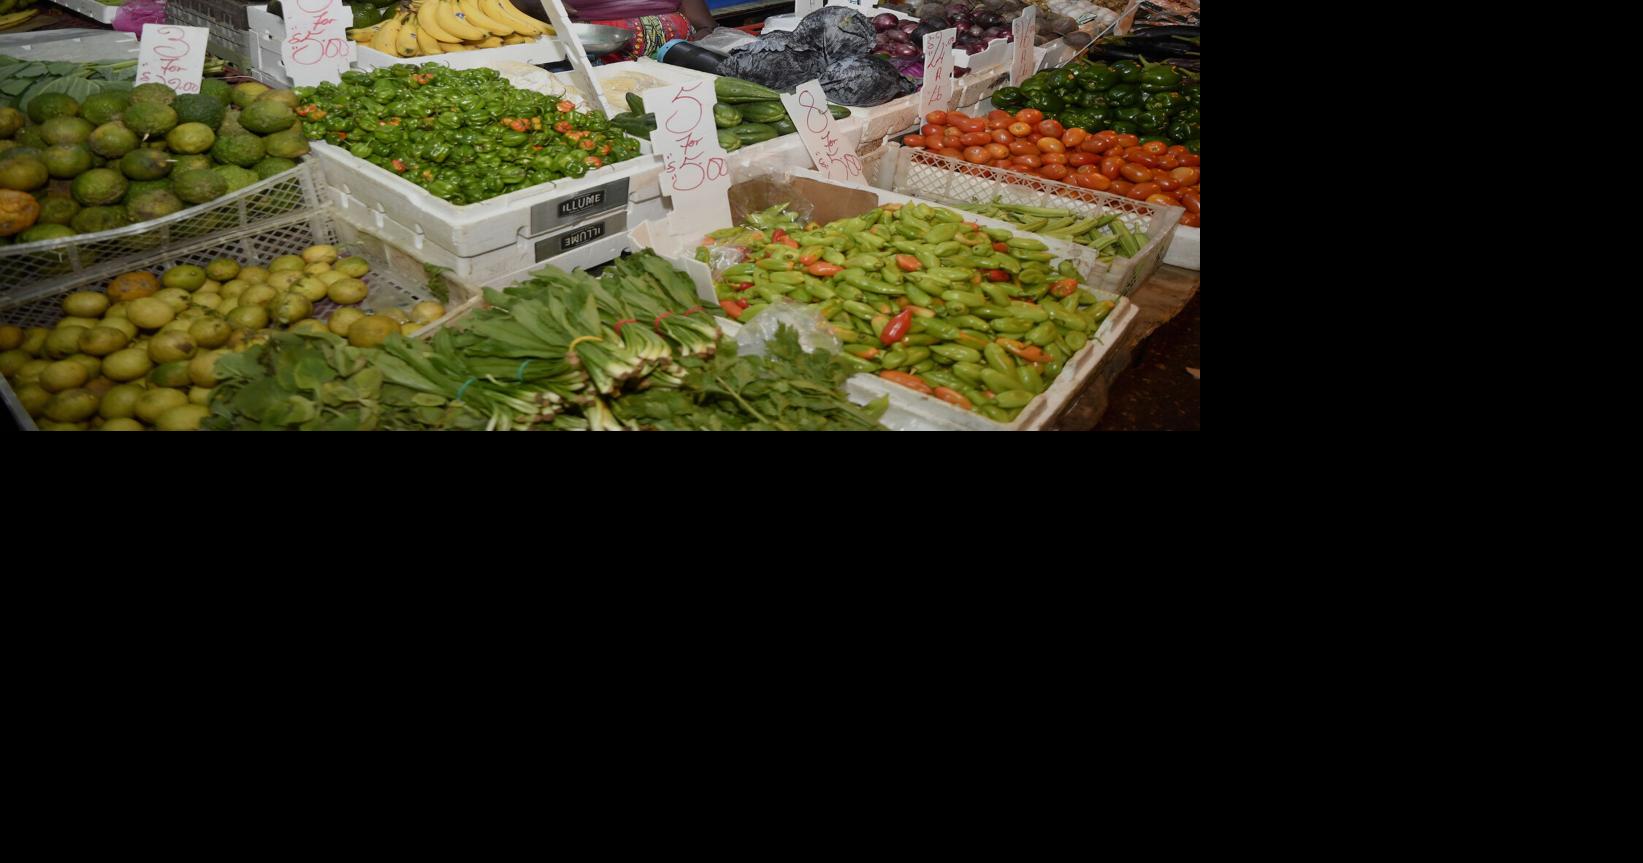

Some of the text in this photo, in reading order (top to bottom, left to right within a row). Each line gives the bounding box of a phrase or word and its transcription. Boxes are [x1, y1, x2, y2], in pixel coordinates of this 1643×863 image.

[153, 26, 190, 59] 3
[665, 81, 704, 134] 5
[798, 90, 828, 134] 8
[562, 193, 601, 212] ILLUME
[564, 227, 601, 247] ILLUME
